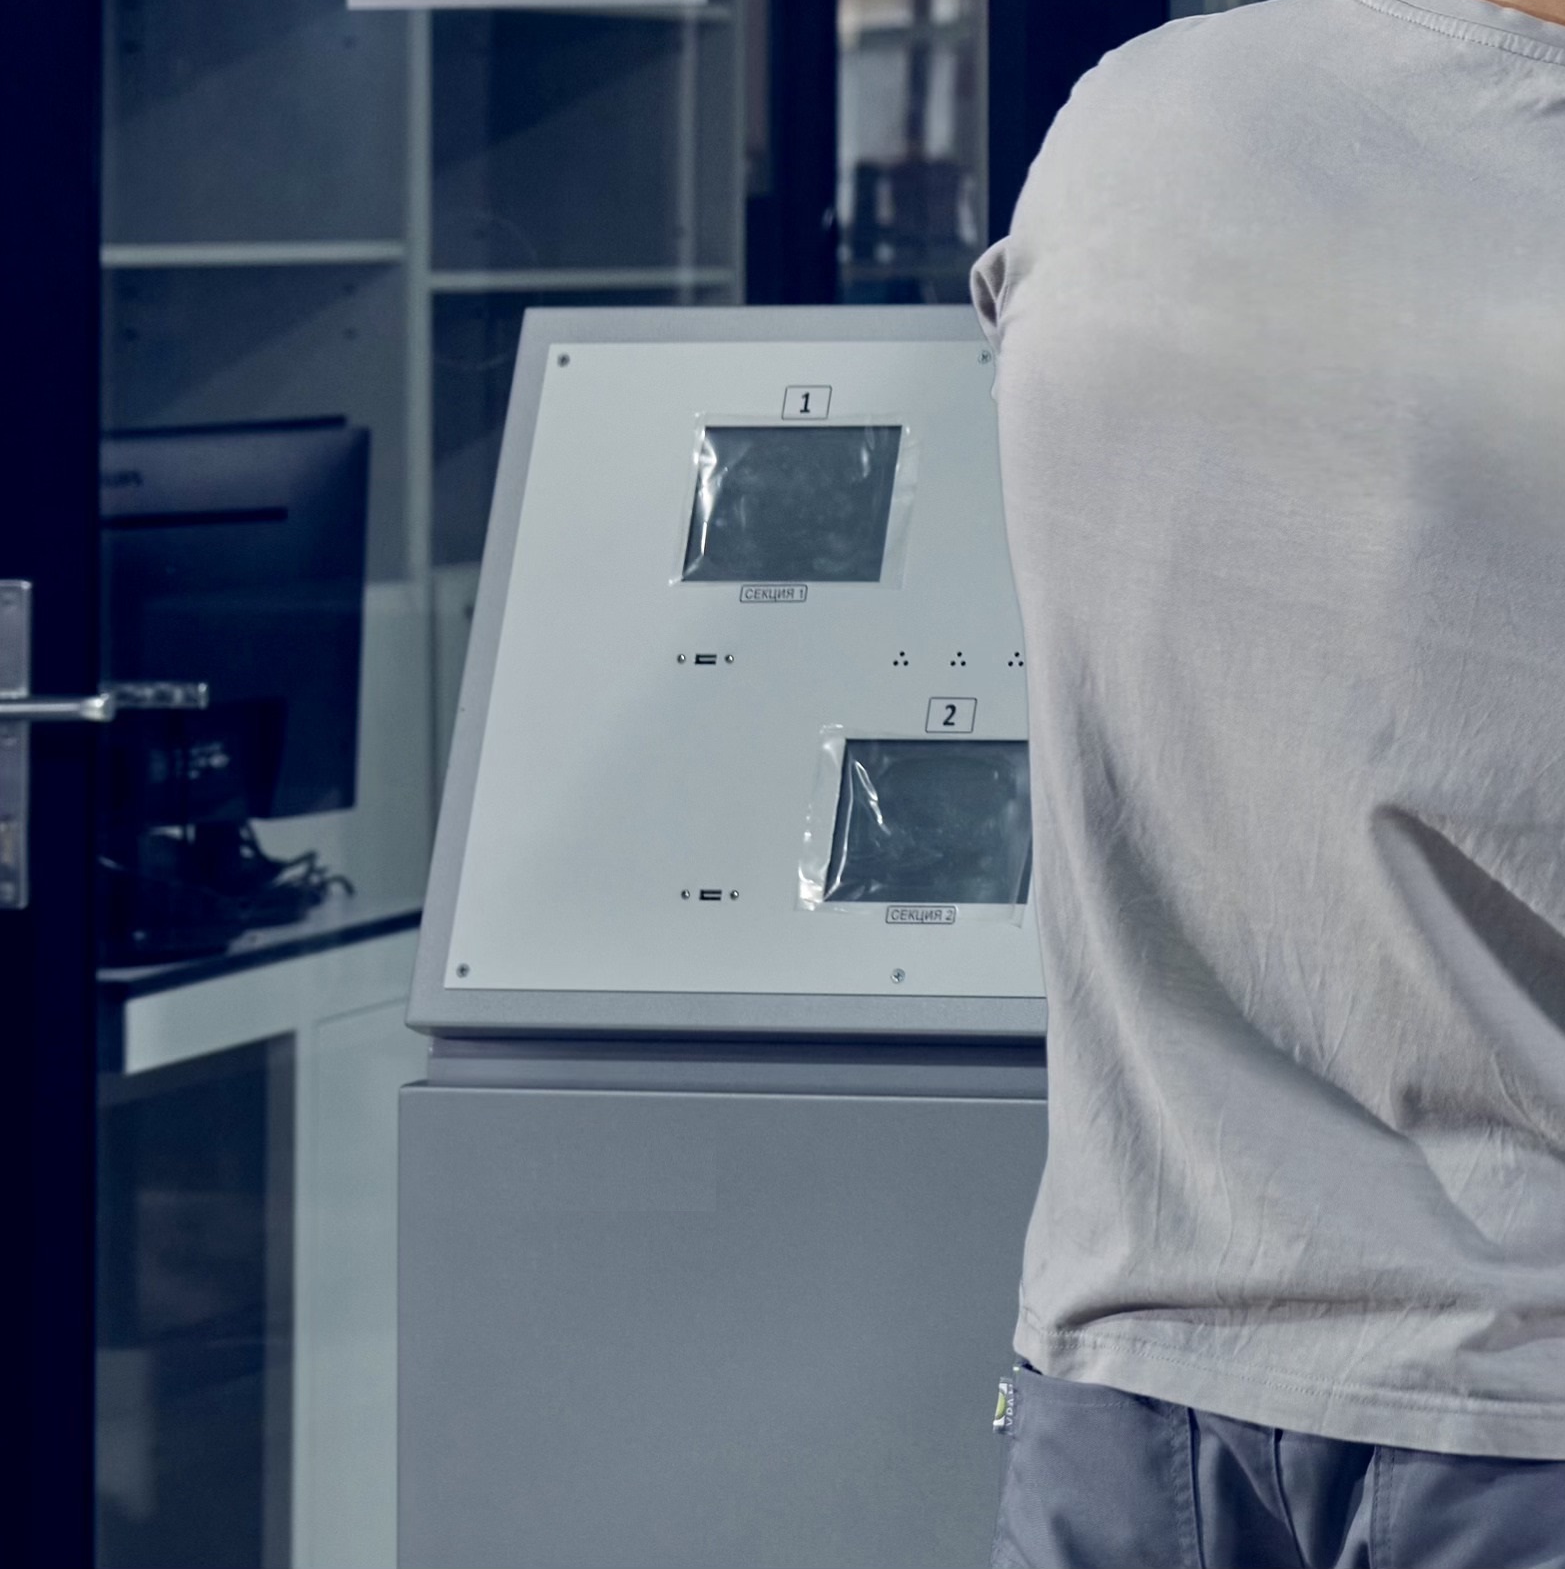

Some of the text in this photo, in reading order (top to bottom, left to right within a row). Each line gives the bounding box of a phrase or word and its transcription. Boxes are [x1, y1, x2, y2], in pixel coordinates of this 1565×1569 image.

[799, 391, 811, 414] 1
[745, 588, 804, 602] СЕКЦИЯ 1
[943, 704, 956, 726] 2
[891, 909, 953, 923] СЕКЦИЯ 2
